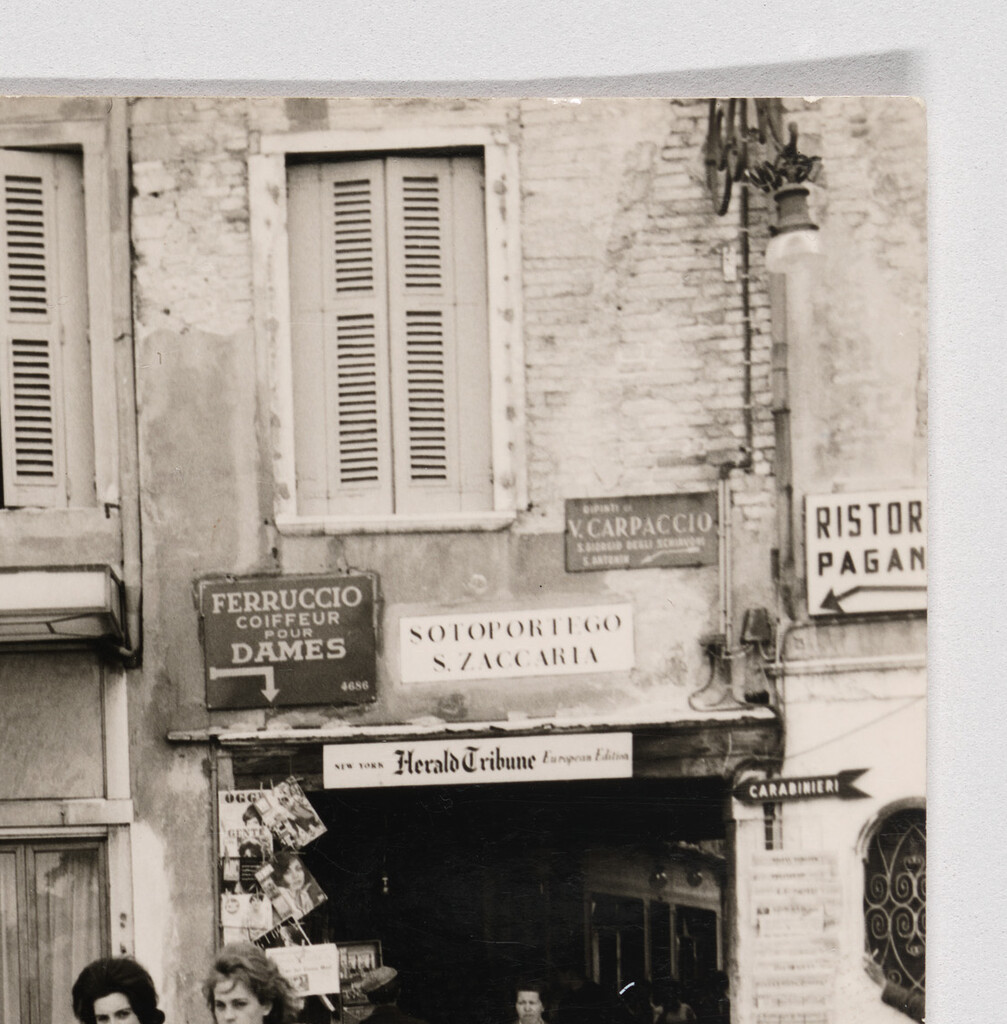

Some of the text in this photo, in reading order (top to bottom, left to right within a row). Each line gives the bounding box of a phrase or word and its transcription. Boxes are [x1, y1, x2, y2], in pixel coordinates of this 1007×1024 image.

[816, 500, 923, 539] RISTOR
[817, 546, 925, 577] PAGAN
[211, 585, 363, 614] FERRUCCIO
[235, 611, 341, 630] COIFFEUR
[264, 627, 313, 639] POUR
[409, 613, 622, 644] SOTOPORTEGO
[230, 638, 347, 665] DAMES
[340, 680, 370, 692] 4686
[334, 745, 630, 776] NEW YORK Herald Tribune European Edition
[748, 778, 840, 799] CARABINIERI
